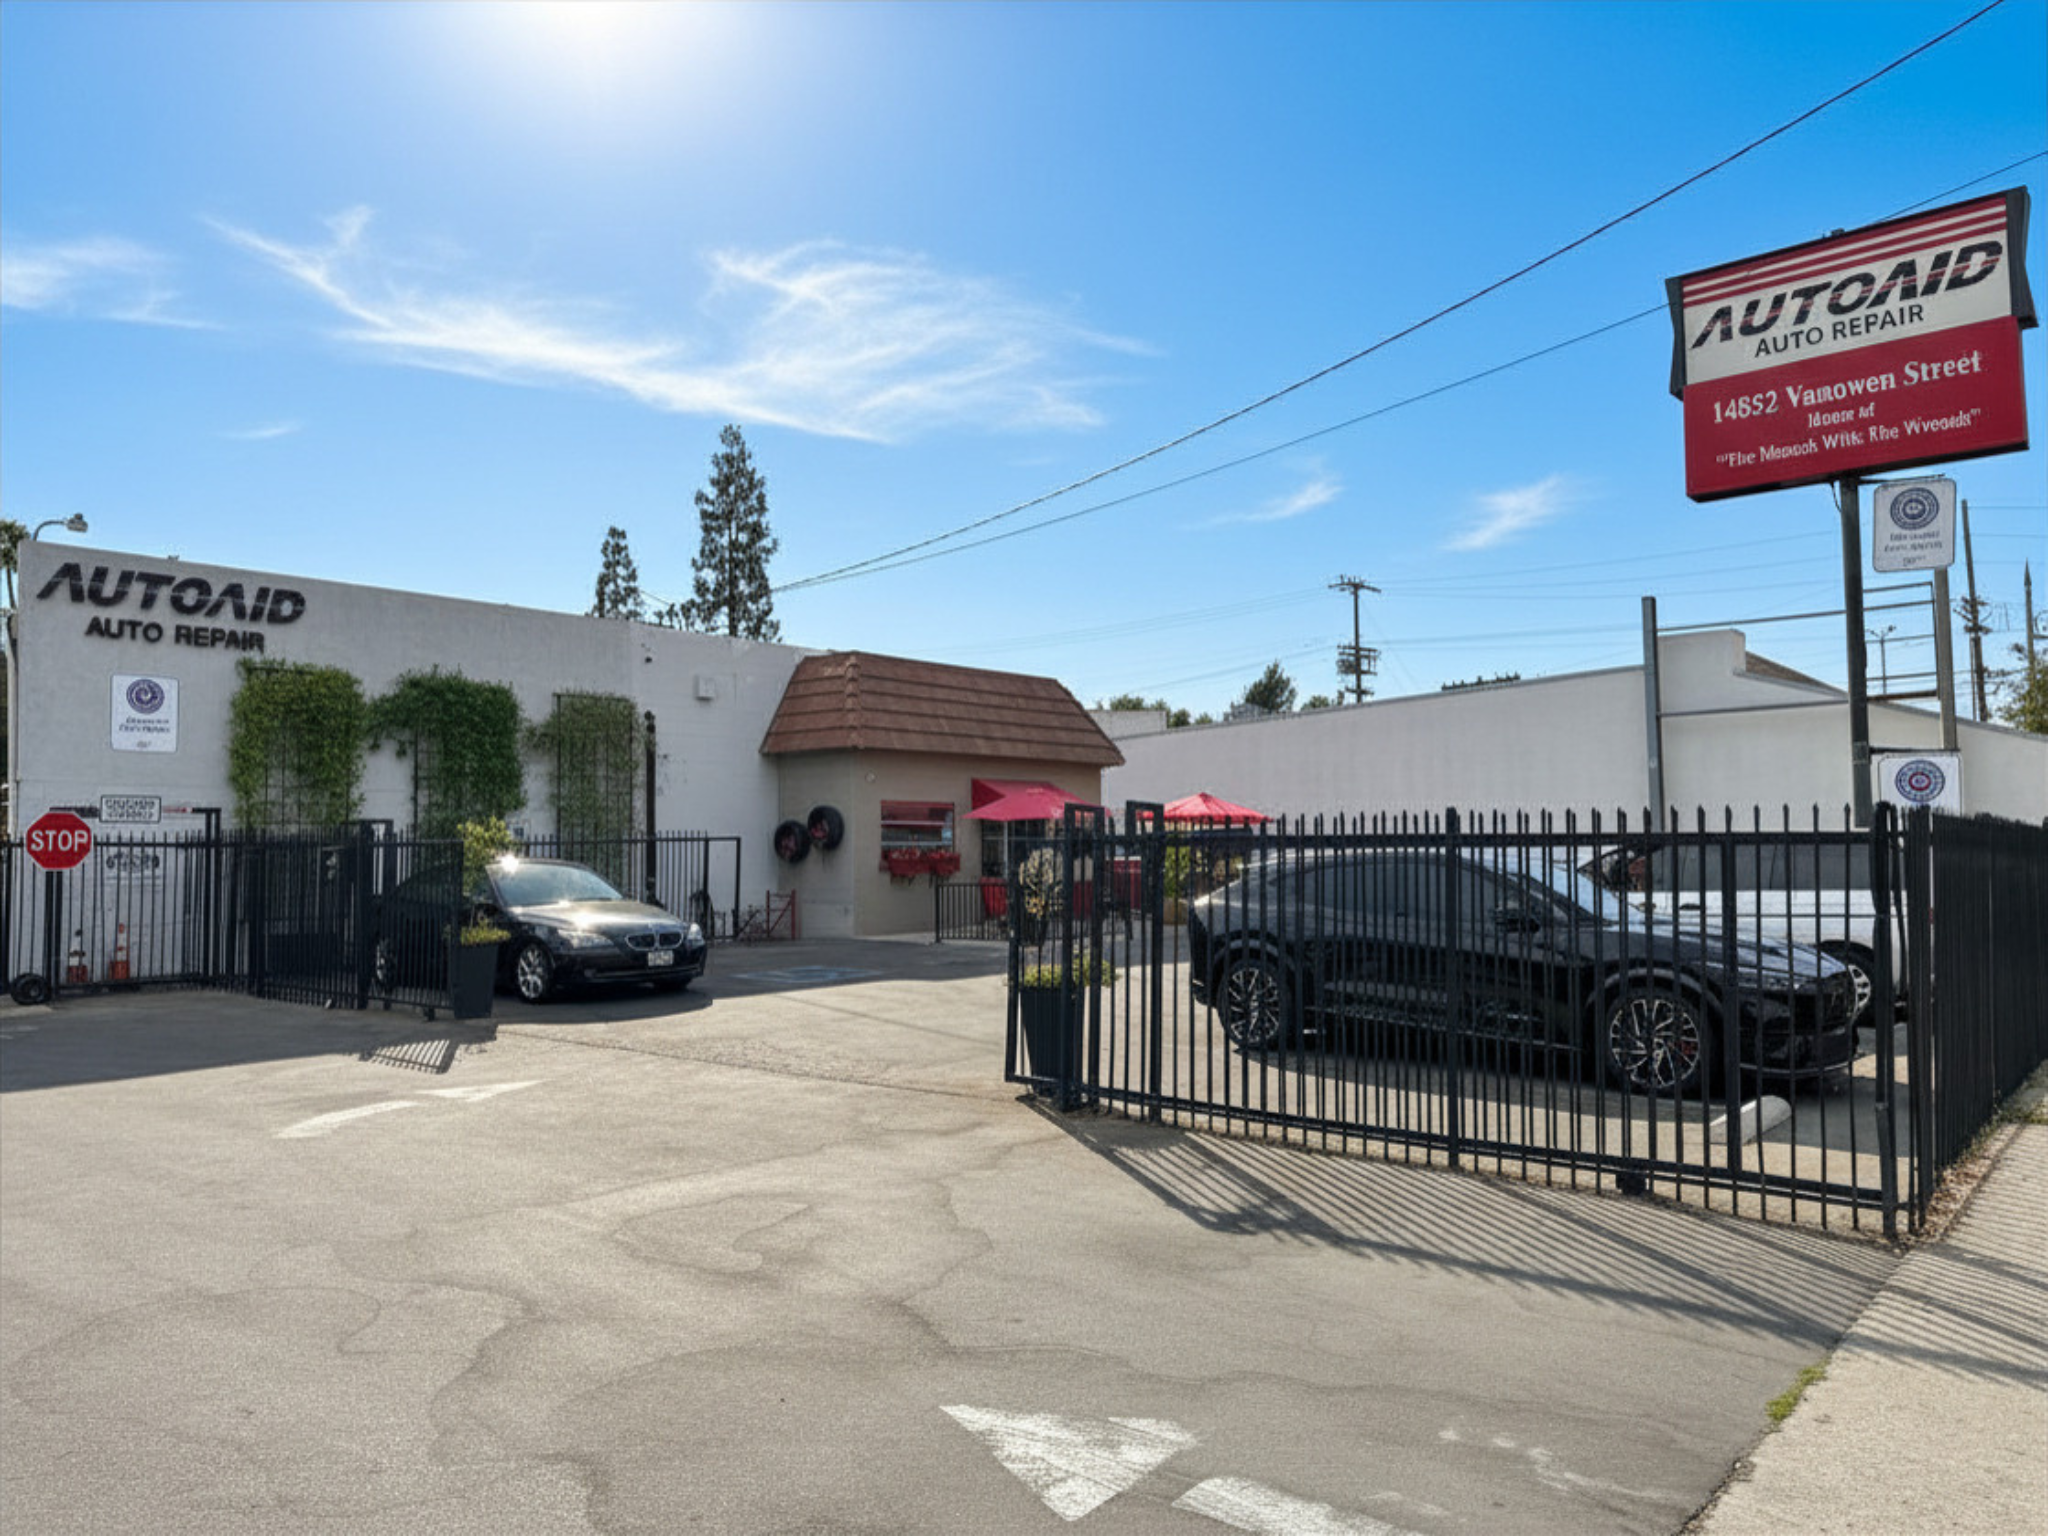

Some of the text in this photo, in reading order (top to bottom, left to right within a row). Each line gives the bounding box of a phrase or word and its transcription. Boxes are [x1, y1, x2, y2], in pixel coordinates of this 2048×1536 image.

[1691, 240, 2003, 349] AUTOAID
[1754, 304, 1924, 358] AUTO REPAIR
[1903, 350, 1983, 386] Street
[36, 562, 306, 625] AUTOAID
[85, 616, 265, 653] AUTO REPAIR
[30, 829, 89, 852] STOP
